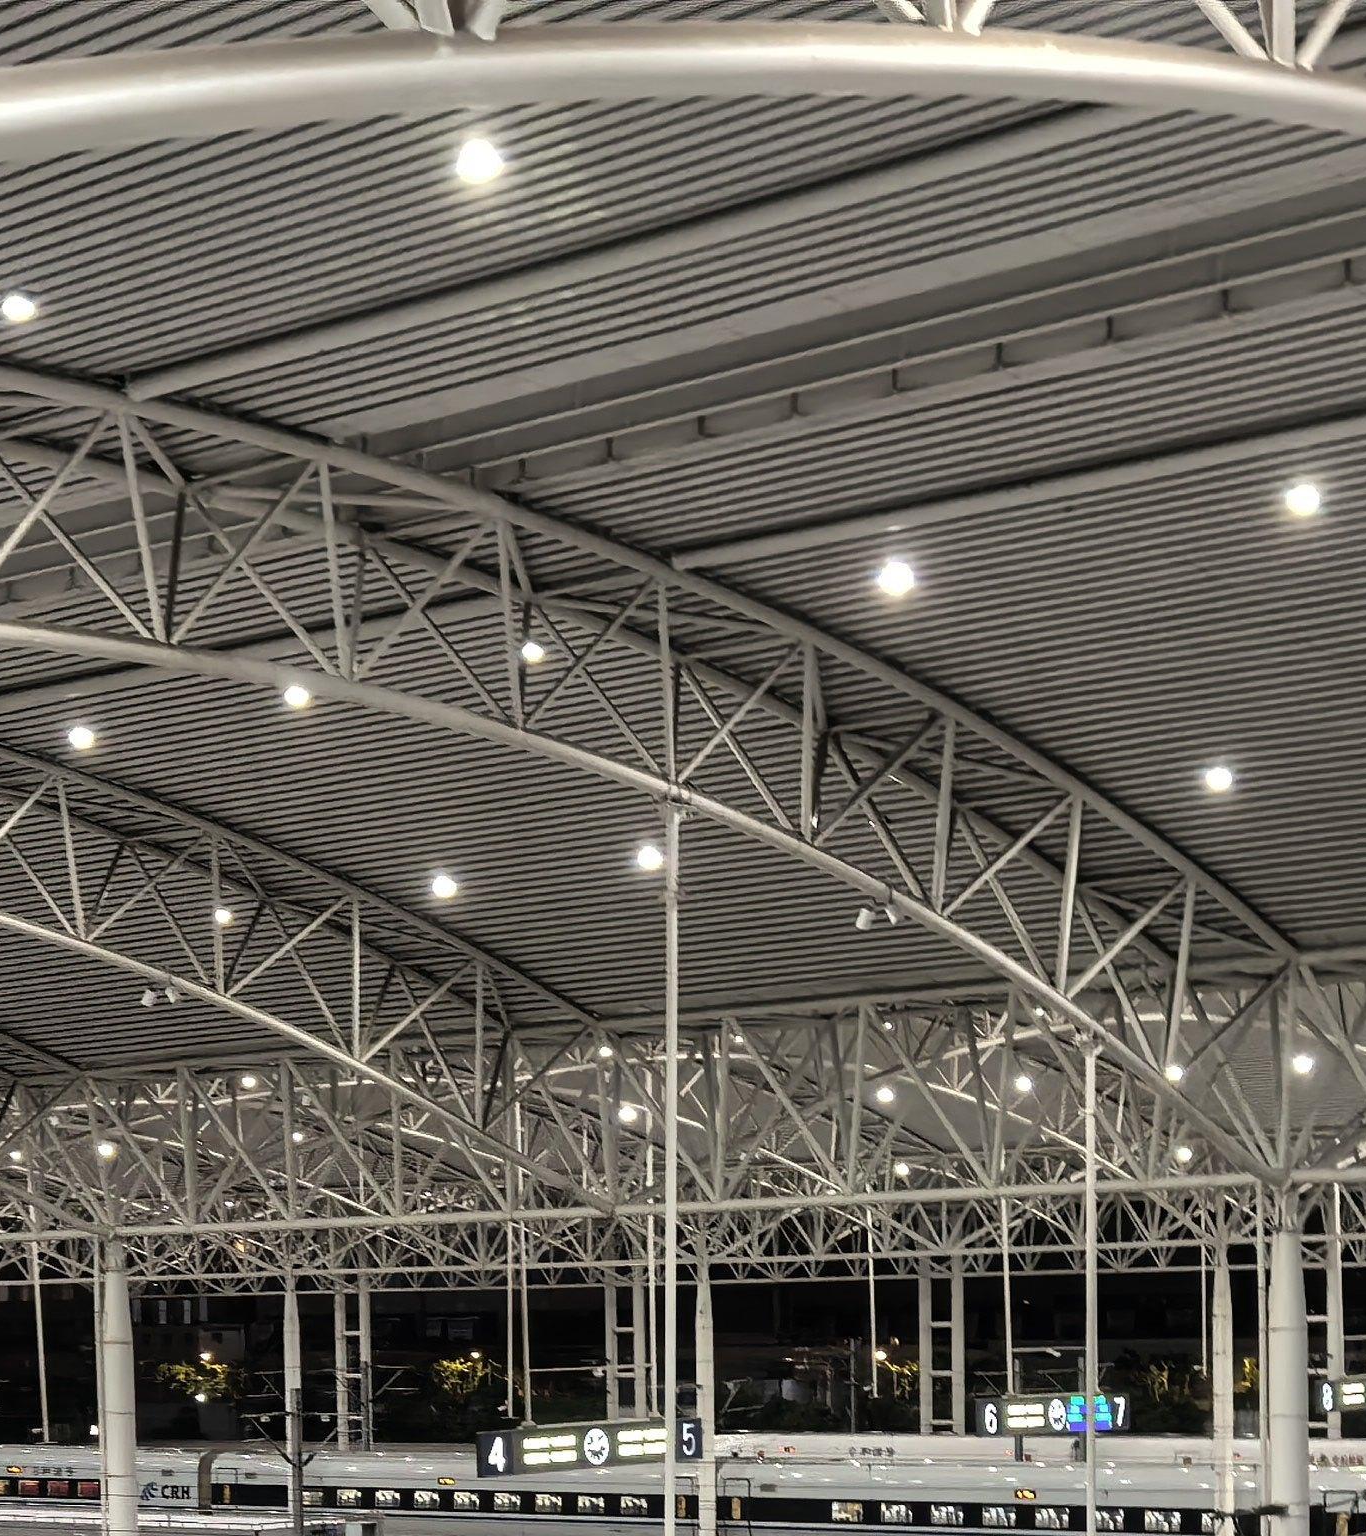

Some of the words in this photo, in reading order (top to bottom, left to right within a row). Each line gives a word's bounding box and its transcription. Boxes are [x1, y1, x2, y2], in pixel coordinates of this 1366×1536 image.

[985, 1403, 998, 1434] 6
[1114, 1396, 1126, 1427] 7
[488, 1436, 506, 1472] 4
[682, 1423, 695, 1455] 5
[160, 1485, 191, 1499] CRH
